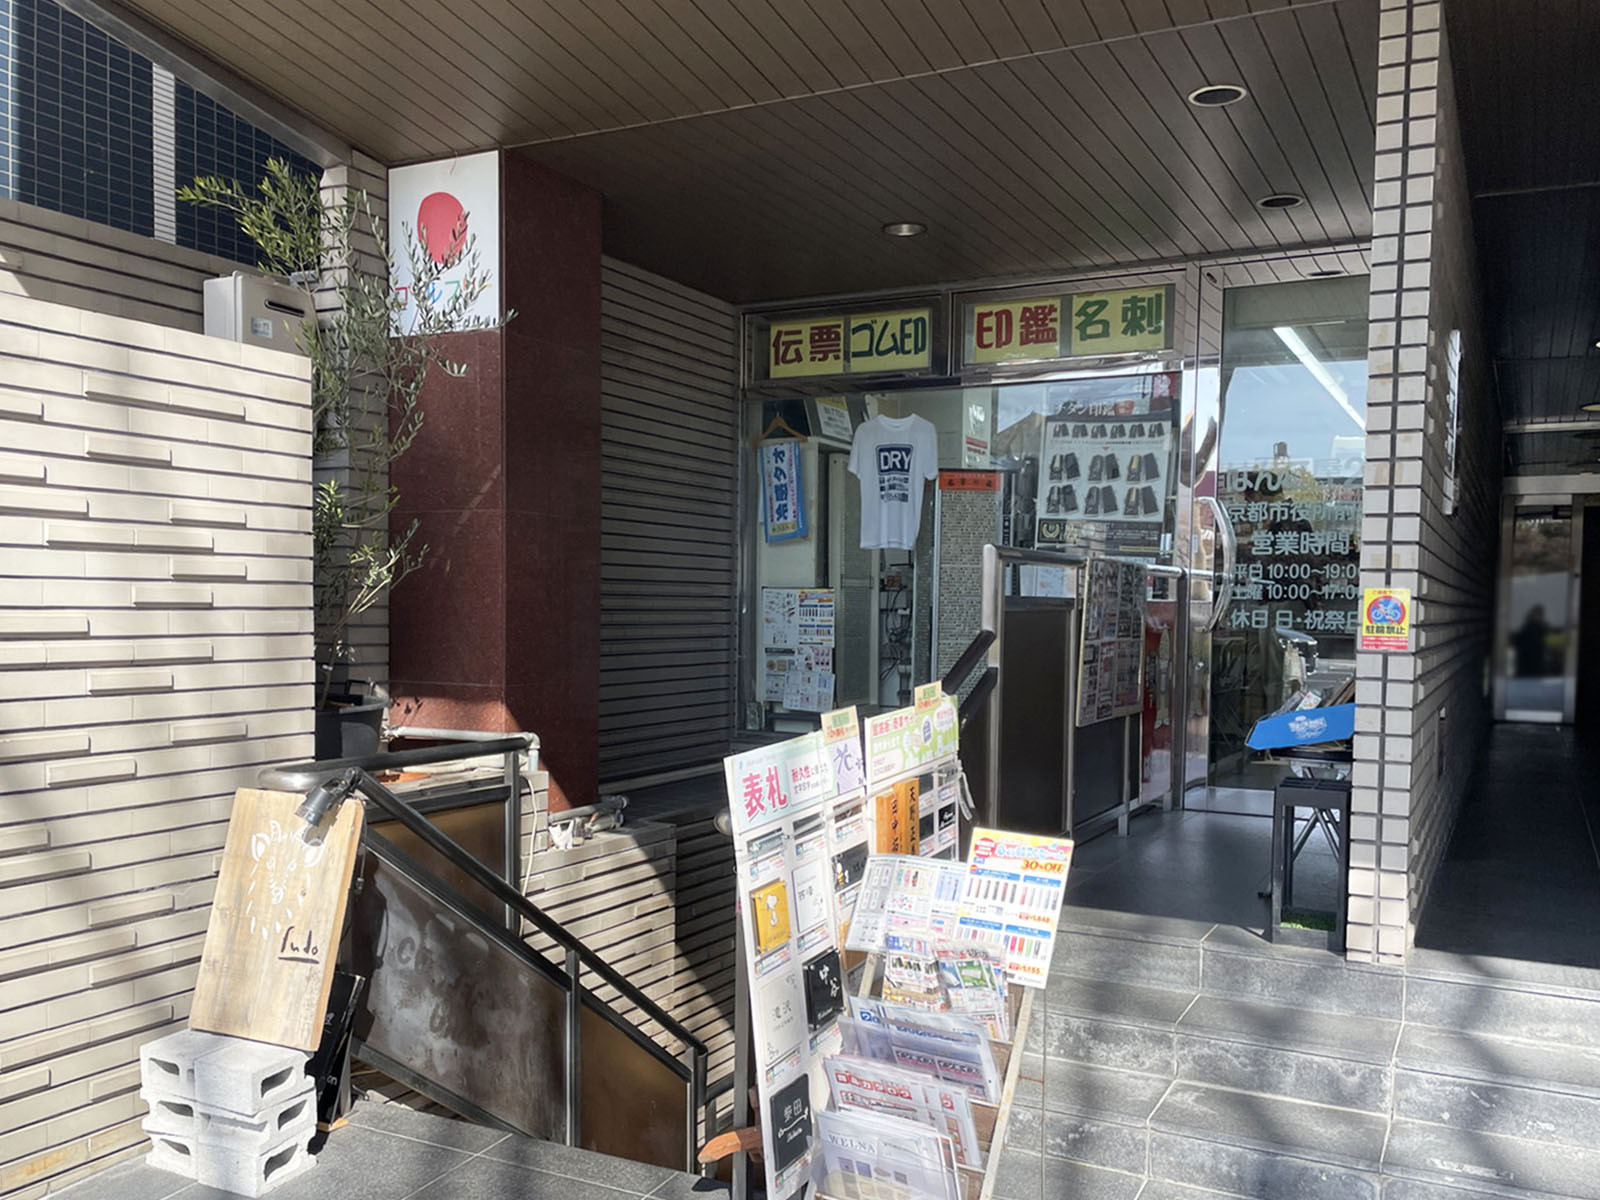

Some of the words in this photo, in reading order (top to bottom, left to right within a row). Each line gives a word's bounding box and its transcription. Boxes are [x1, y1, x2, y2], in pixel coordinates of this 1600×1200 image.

[851, 316, 926, 359] ゴム印
[976, 304, 1058, 349] 印鑑
[1074, 293, 1163, 342] 名刺
[772, 323, 842, 366] 伝票
[880, 450, 912, 471] DRY
[771, 444, 789, 522] 冷感タオ
[1251, 530, 1350, 556] 営業時間
[1233, 563, 1263, 580] 平日
[1266, 583, 1360, 599] 10:00〜17:0
[1231, 608, 1269, 628] 休日
[742, 765, 788, 818] 表札
